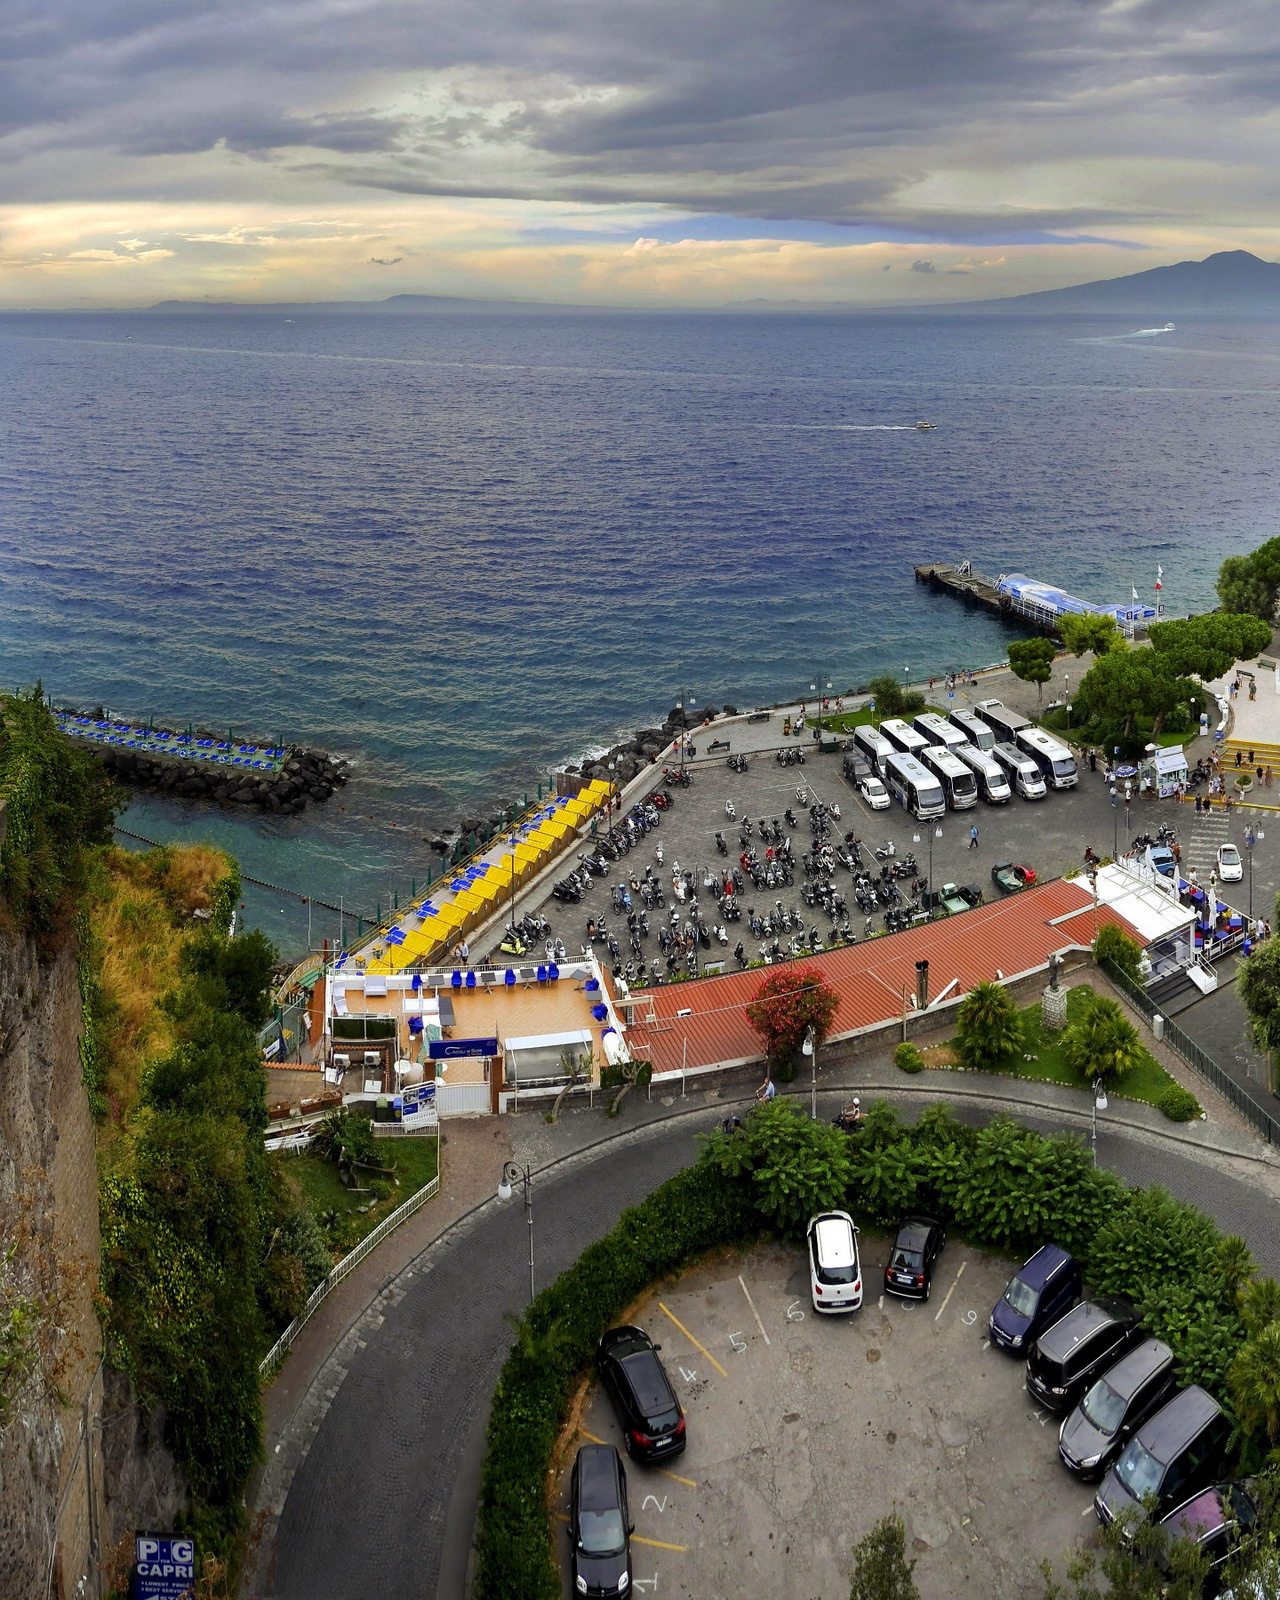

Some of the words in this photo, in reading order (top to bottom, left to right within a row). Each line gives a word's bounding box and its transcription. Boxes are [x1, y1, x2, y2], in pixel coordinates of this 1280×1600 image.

[787, 1300, 805, 1321] 6
[729, 1331, 747, 1354] 5
[679, 1366, 697, 1382] 4
[641, 1495, 668, 1513] 2
[139, 1540, 158, 1560] P
[172, 1542, 192, 1562] G
[137, 1563, 193, 1578] CAPRI
[632, 1572, 658, 1593] 1
